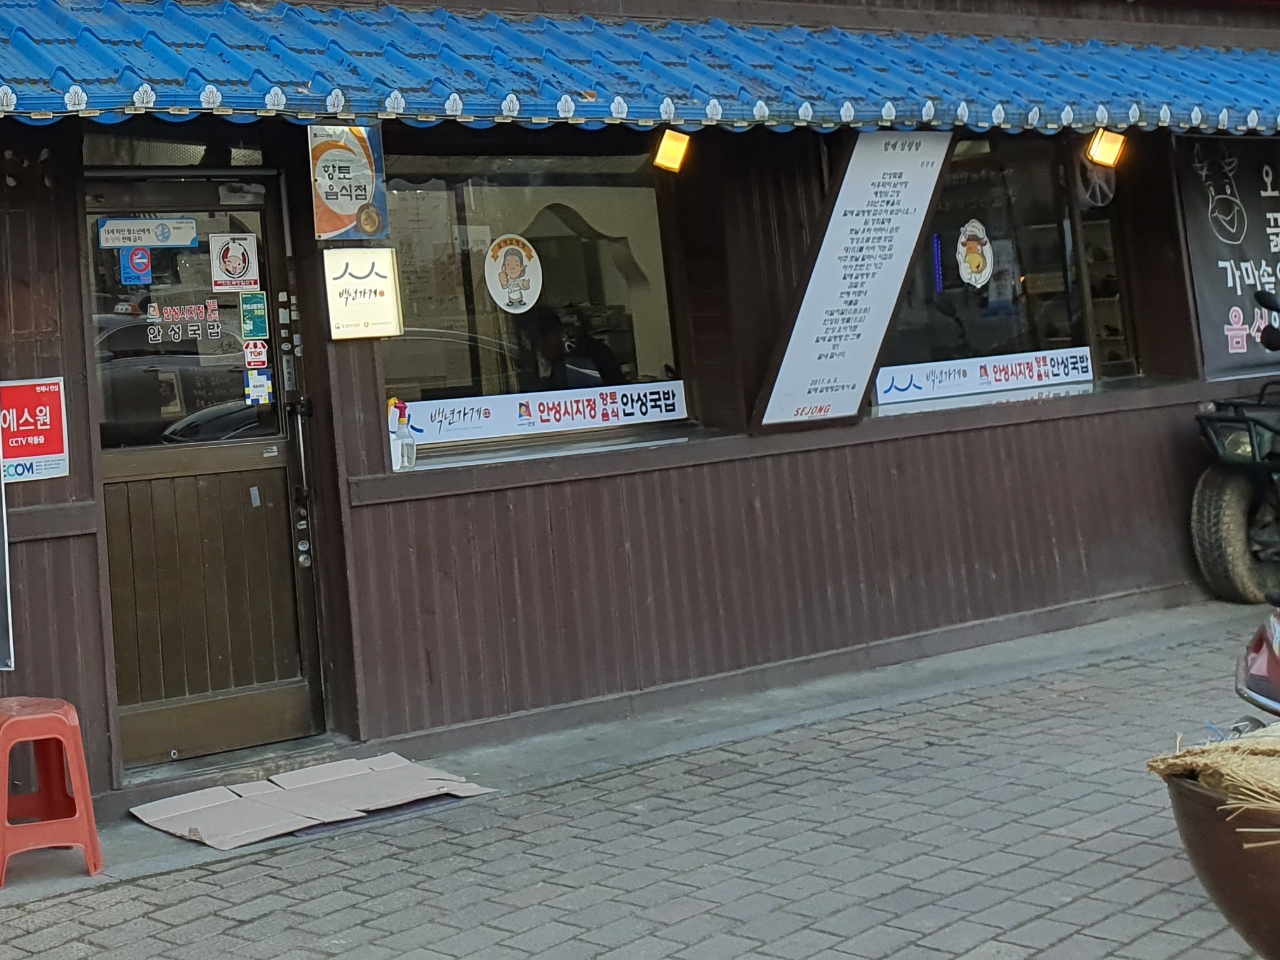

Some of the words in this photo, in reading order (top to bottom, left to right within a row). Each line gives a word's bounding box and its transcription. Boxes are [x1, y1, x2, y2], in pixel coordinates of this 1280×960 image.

[322, 163, 353, 181] 향토
[324, 183, 368, 202] 음식점
[163, 304, 205, 322] 안성시지정
[147, 322, 222, 344] 안성국밥
[992, 361, 1035, 383] 안성시지정
[1049, 354, 1090, 378] 안성국밥
[537, 397, 598, 424] 안성시지정
[620, 389, 677, 418] 안성국밥
[793, 404, 832, 417] SEJONG
[0, 405, 51, 432] 에스원
[430, 405, 482, 434] 백년가게
[9, 437, 26, 447] CCTV
